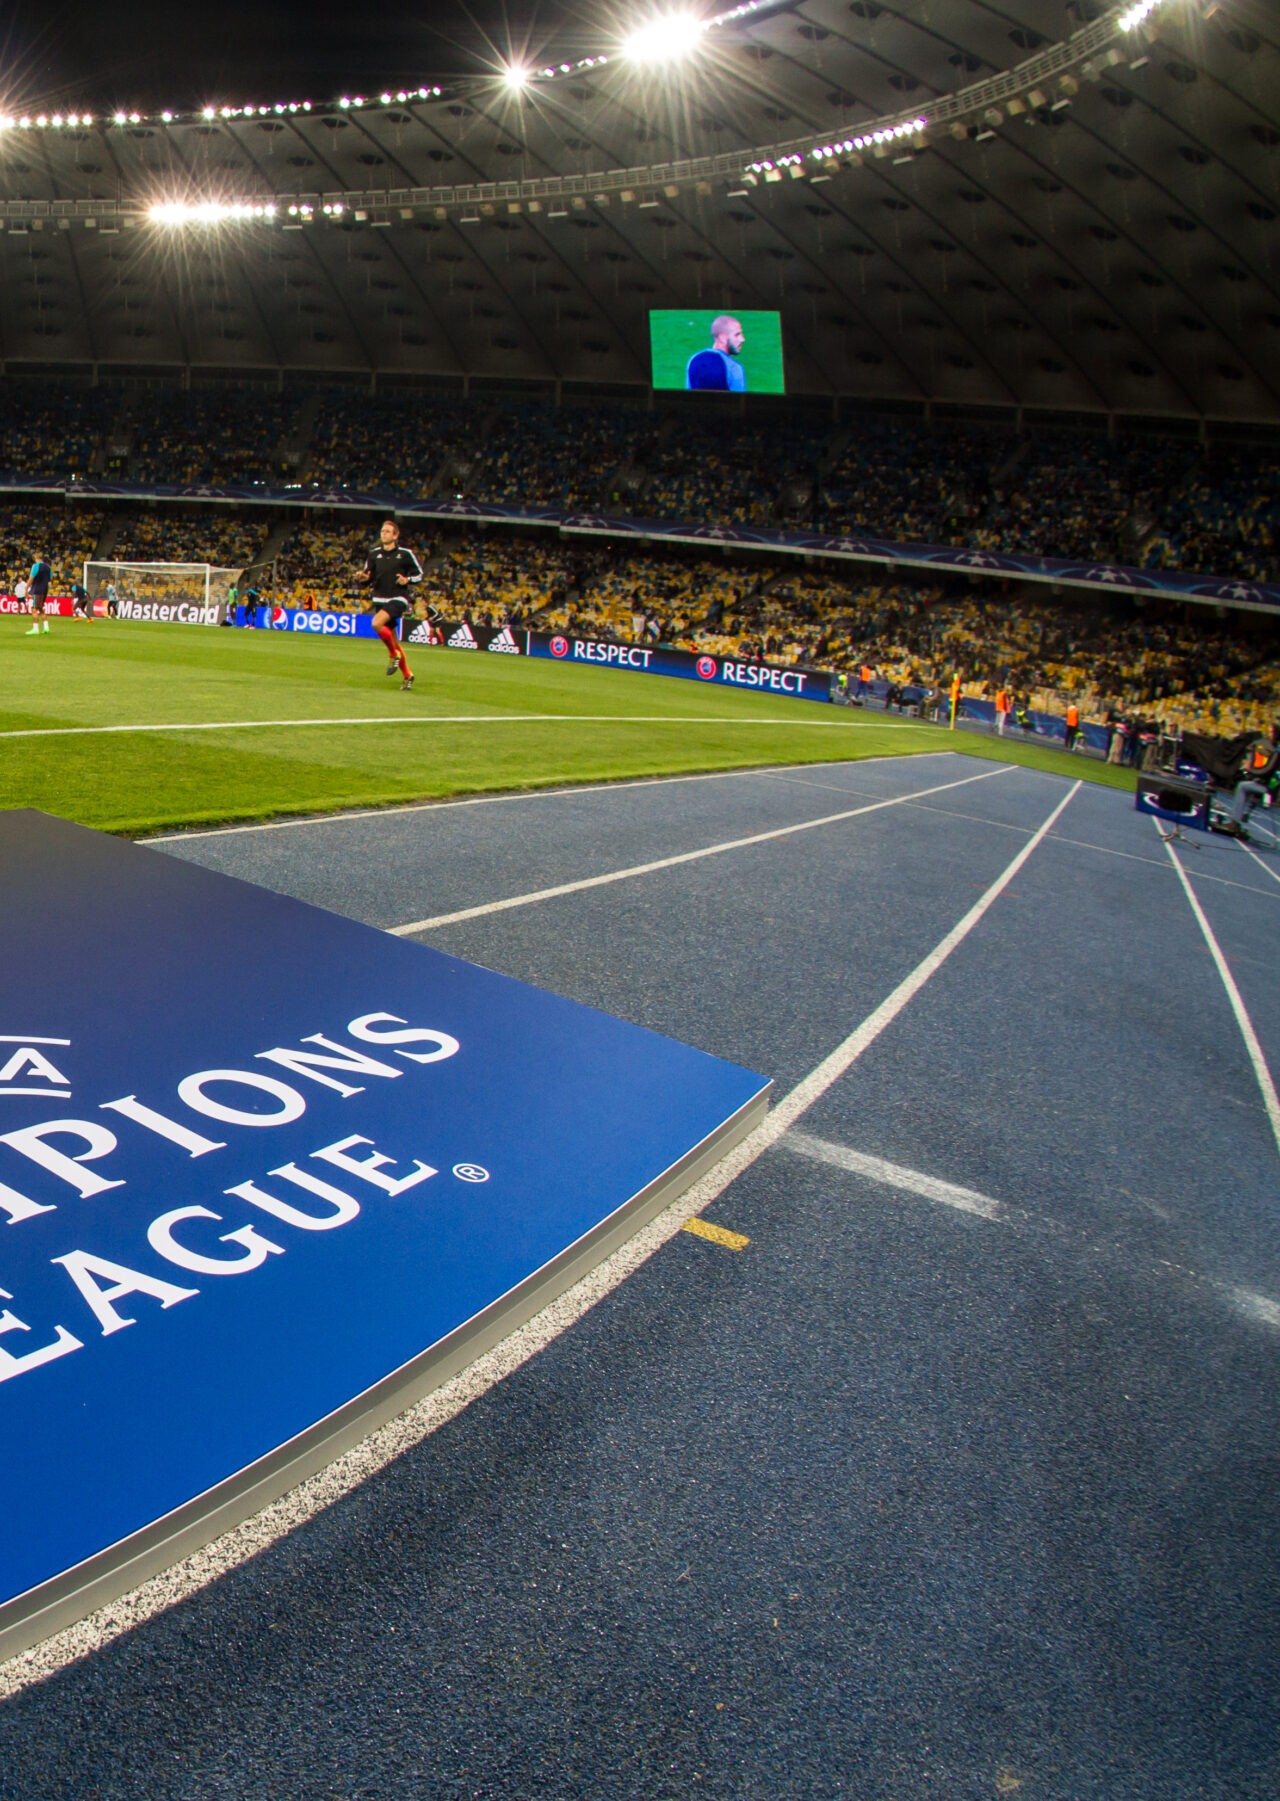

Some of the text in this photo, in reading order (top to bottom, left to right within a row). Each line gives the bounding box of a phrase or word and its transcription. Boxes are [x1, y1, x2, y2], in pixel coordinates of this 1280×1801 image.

[118, 600, 220, 624] MasterCard
[293, 610, 357, 634] pepsi
[447, 638, 479, 650] adidas
[487, 643, 520, 655] adidas
[574, 640, 653, 668] RESPECT
[722, 661, 808, 692] RESPECT
